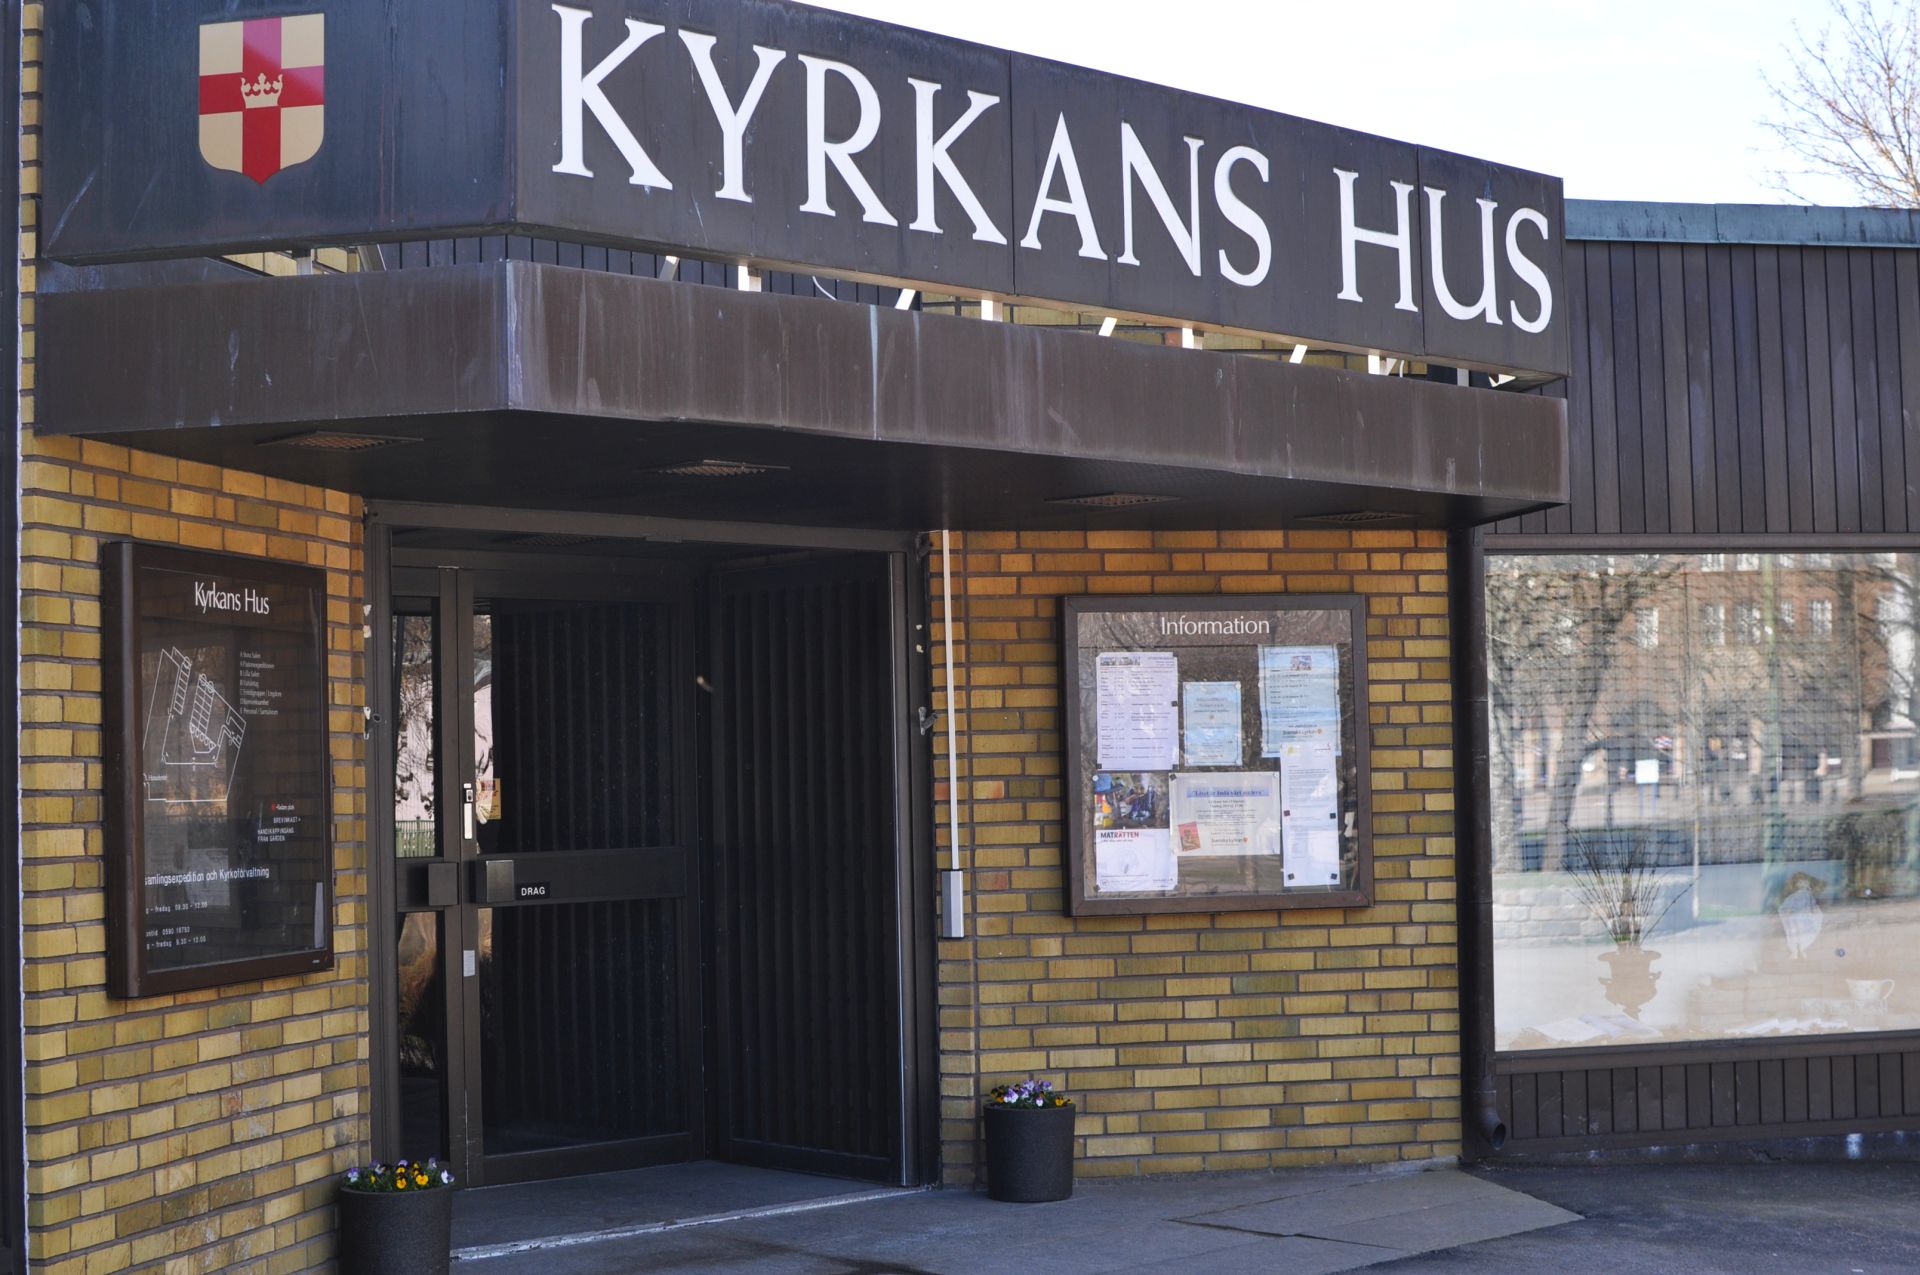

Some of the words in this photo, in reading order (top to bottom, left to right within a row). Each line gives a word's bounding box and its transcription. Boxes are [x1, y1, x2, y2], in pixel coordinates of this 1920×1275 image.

[552, 4, 1272, 287] KYRKANS
[1333, 167, 1554, 333] HUS
[195, 580, 241, 614] Kyrkans
[244, 587, 270, 615] Hus
[1161, 614, 1270, 635] Information
[206, 870, 218, 881] och
[219, 867, 270, 881] Kyrkoförvaltning
[521, 886, 546, 896] DRAG
